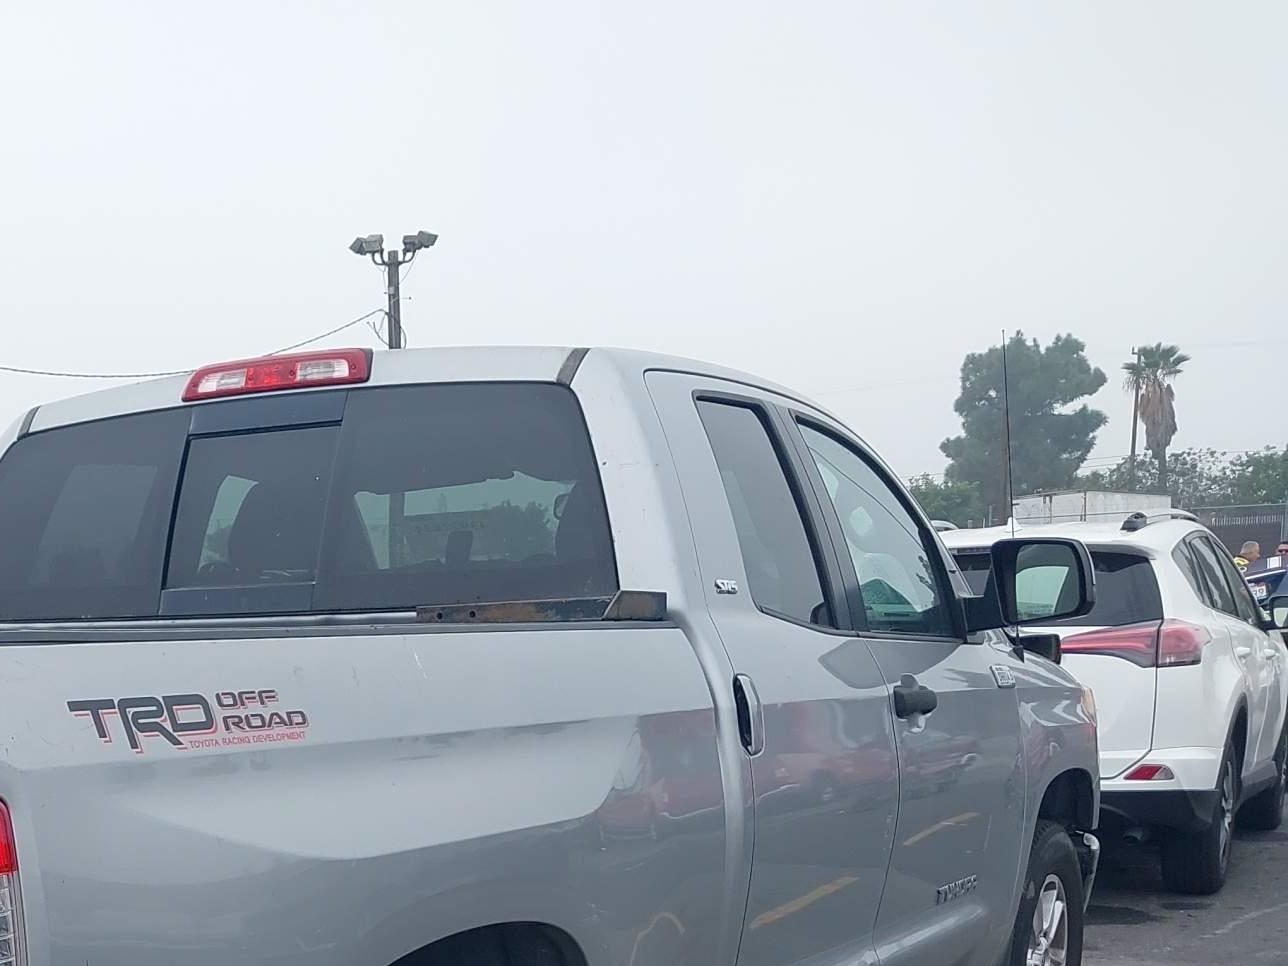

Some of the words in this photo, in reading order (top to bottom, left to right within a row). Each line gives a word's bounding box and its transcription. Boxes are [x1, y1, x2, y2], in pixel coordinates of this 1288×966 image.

[215, 689, 278, 710] OFF
[66, 693, 218, 753] TRD
[221, 710, 309, 732] ROAD
[189, 739, 220, 749] TOYOTA
[222, 735, 251, 746] RACING
[253, 731, 306, 743] DEVELOPMENT
